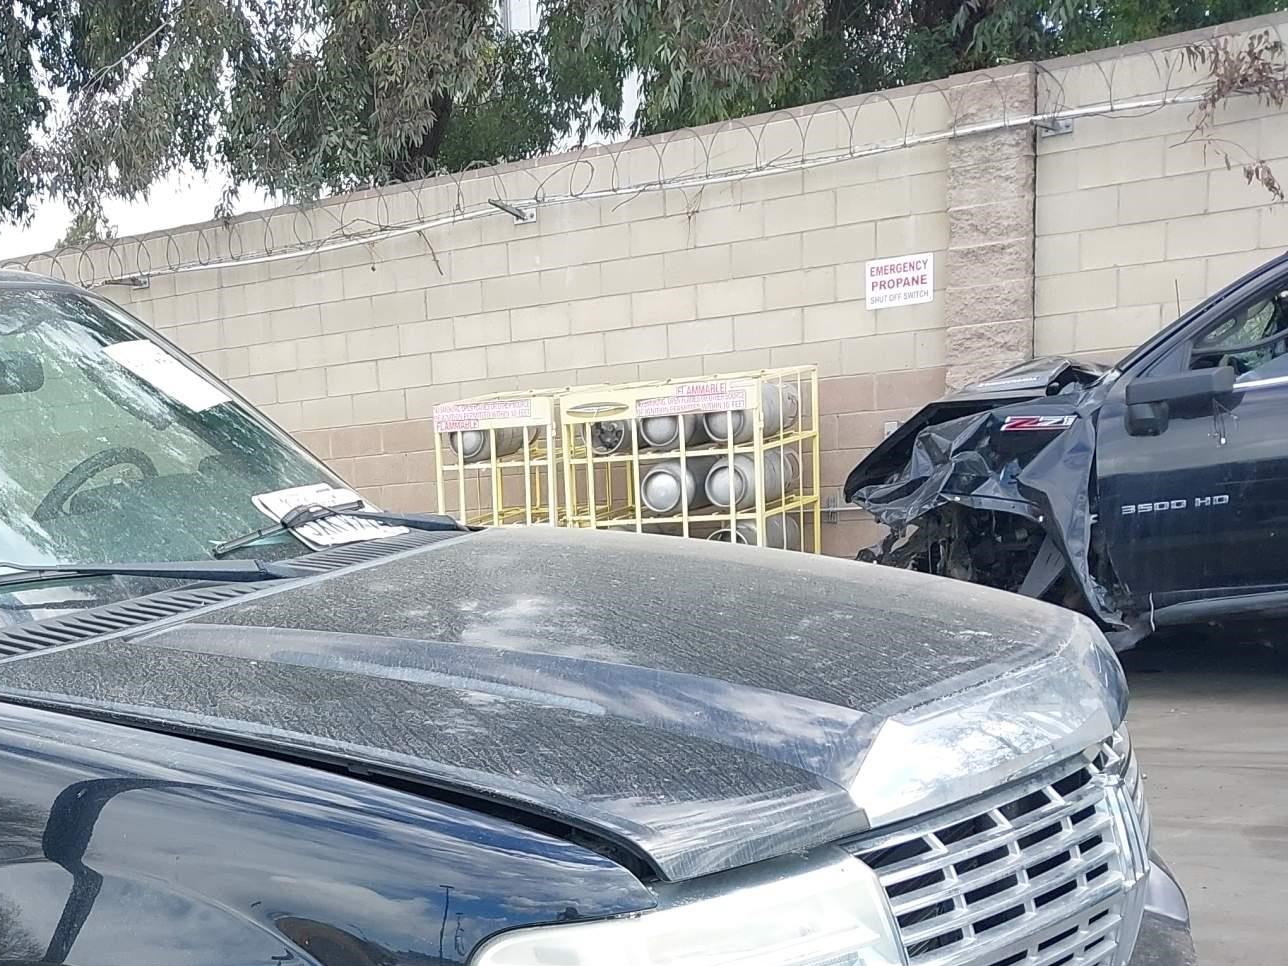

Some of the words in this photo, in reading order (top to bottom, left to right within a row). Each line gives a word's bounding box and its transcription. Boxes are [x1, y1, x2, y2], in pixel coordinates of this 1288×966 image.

[870, 258, 929, 277] EMERGENCY
[871, 274, 928, 292] PROPANE
[870, 294, 888, 305] SHUT
[903, 289, 929, 300] SWITCH
[1121, 499, 1187, 515] 3500
[1194, 495, 1229, 507] HD
